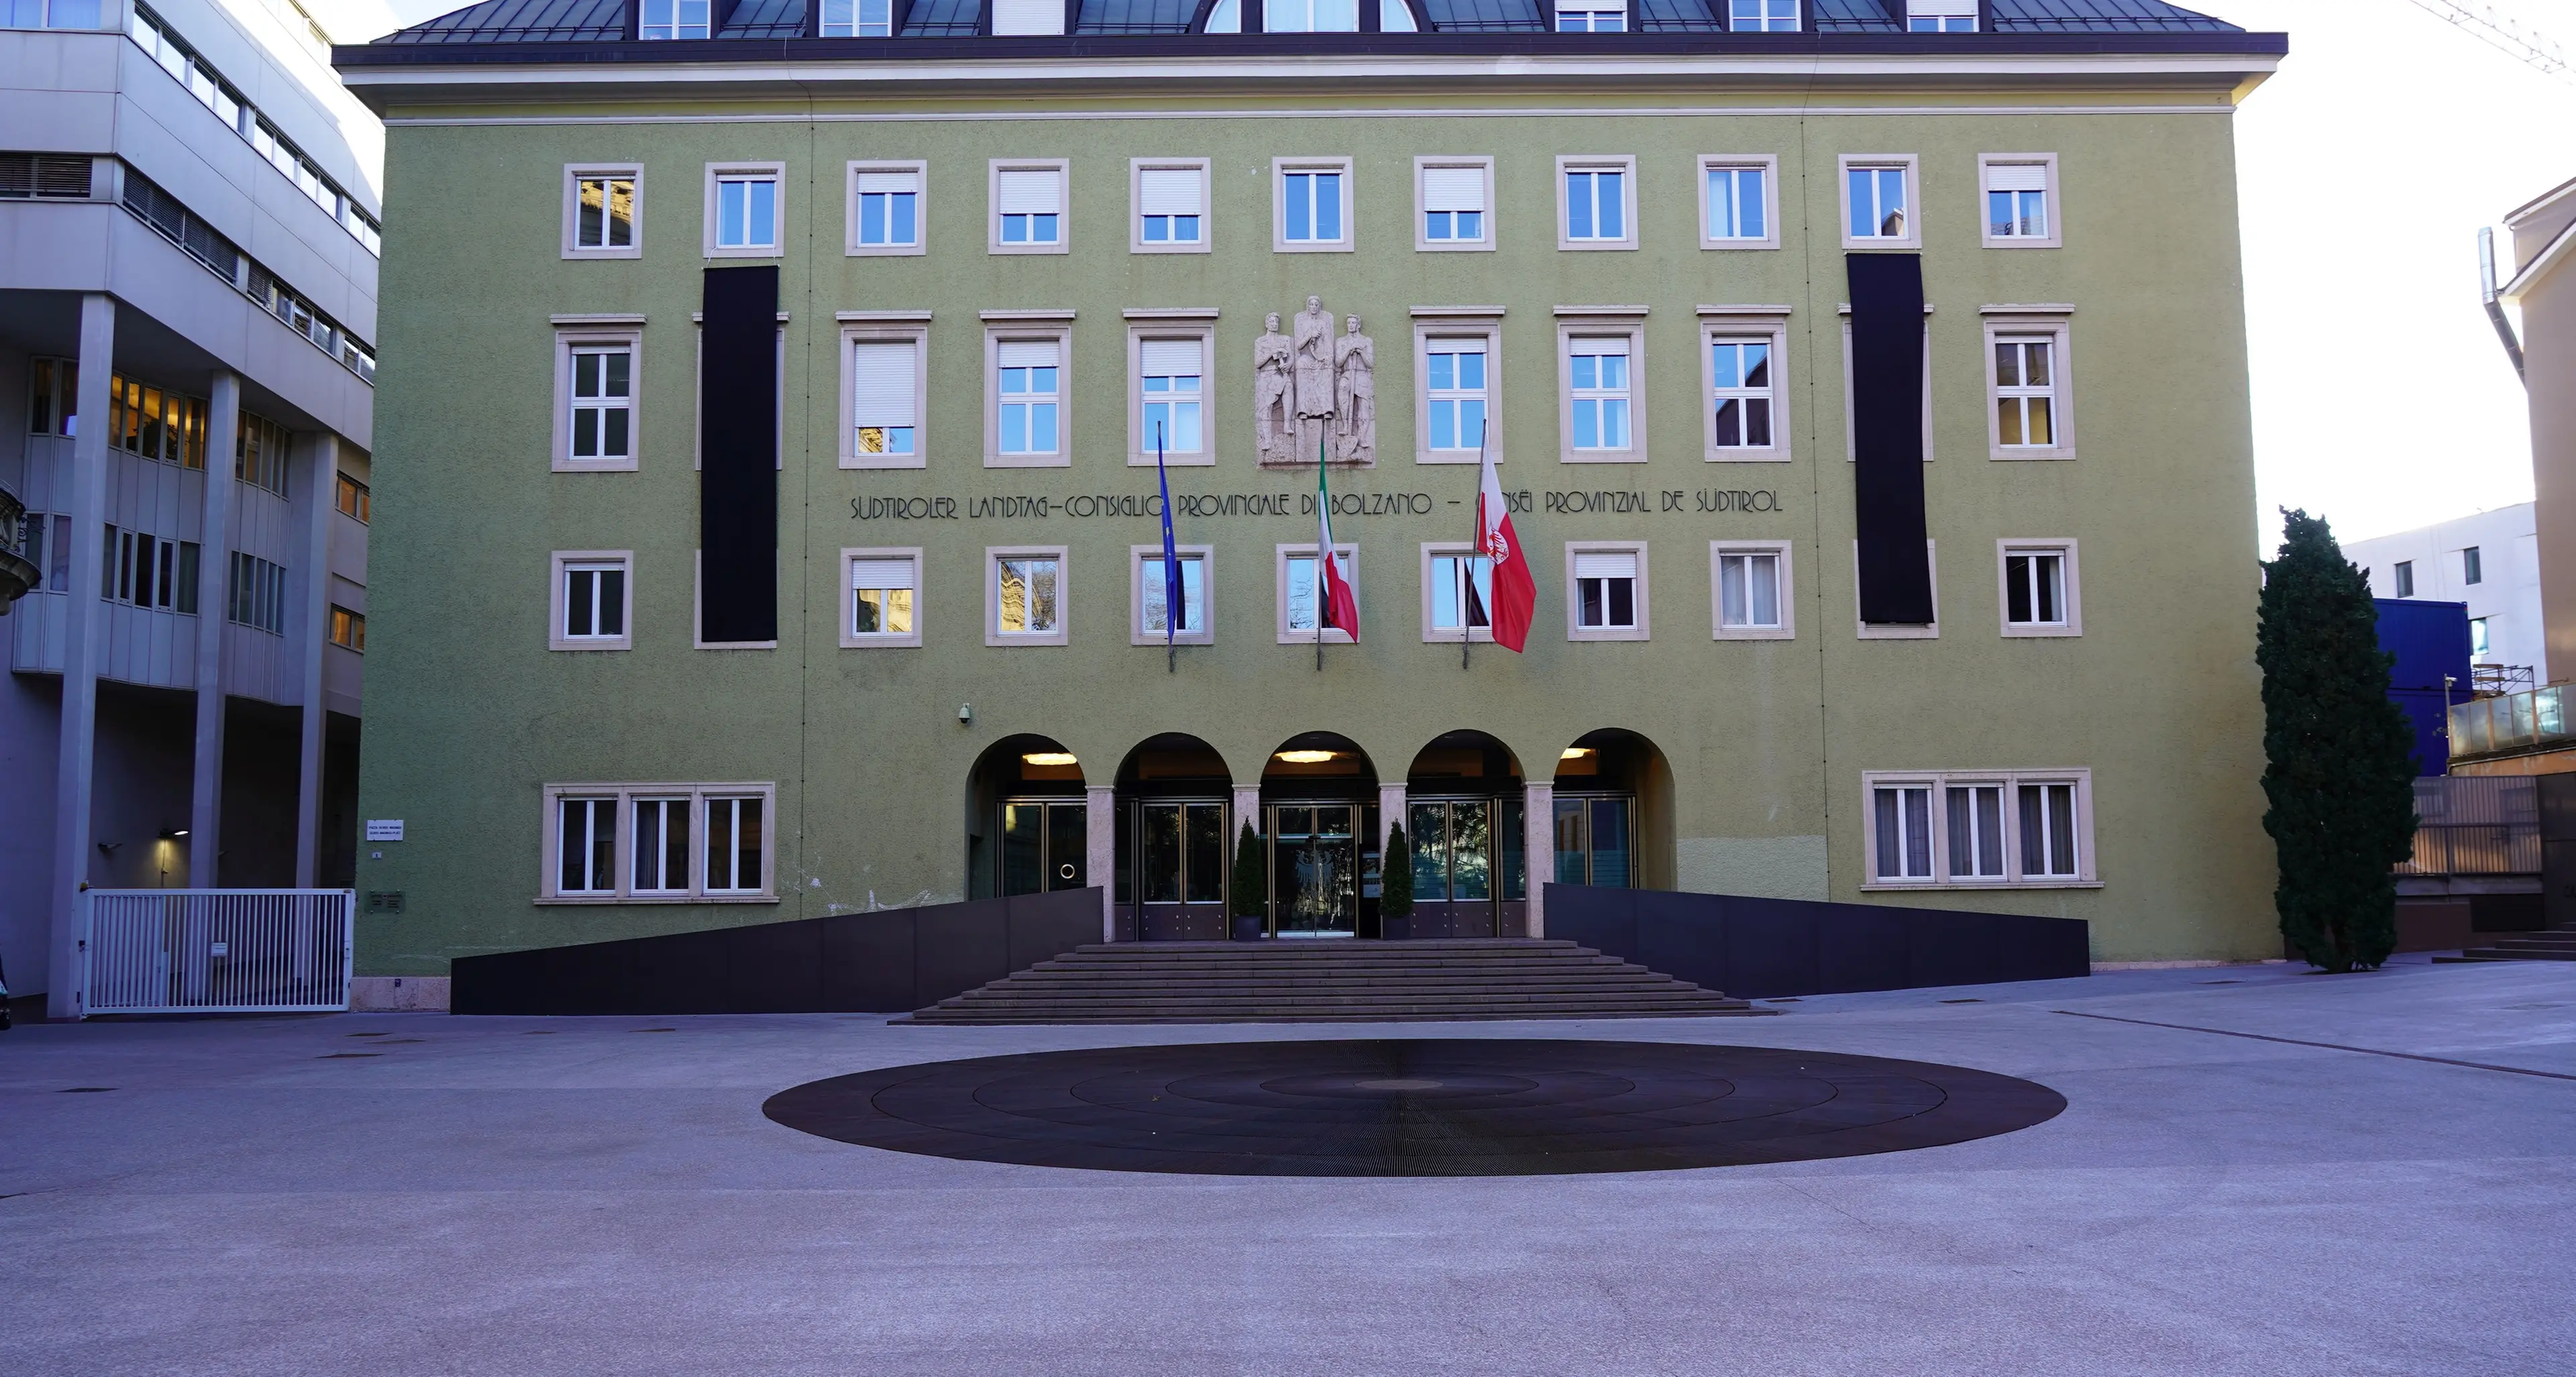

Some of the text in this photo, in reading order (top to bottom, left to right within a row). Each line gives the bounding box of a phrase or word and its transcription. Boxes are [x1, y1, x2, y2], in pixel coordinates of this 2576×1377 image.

[1177, 493, 1291, 516] PROVINCIALE
[1301, 492, 1317, 516] DI
[1331, 492, 1433, 516] BOLZANO
[1545, 490, 1652, 514] PROVINZIAL
[1662, 490, 1684, 512] DE
[1696, 487, 1783, 512] SÜDTIROL
